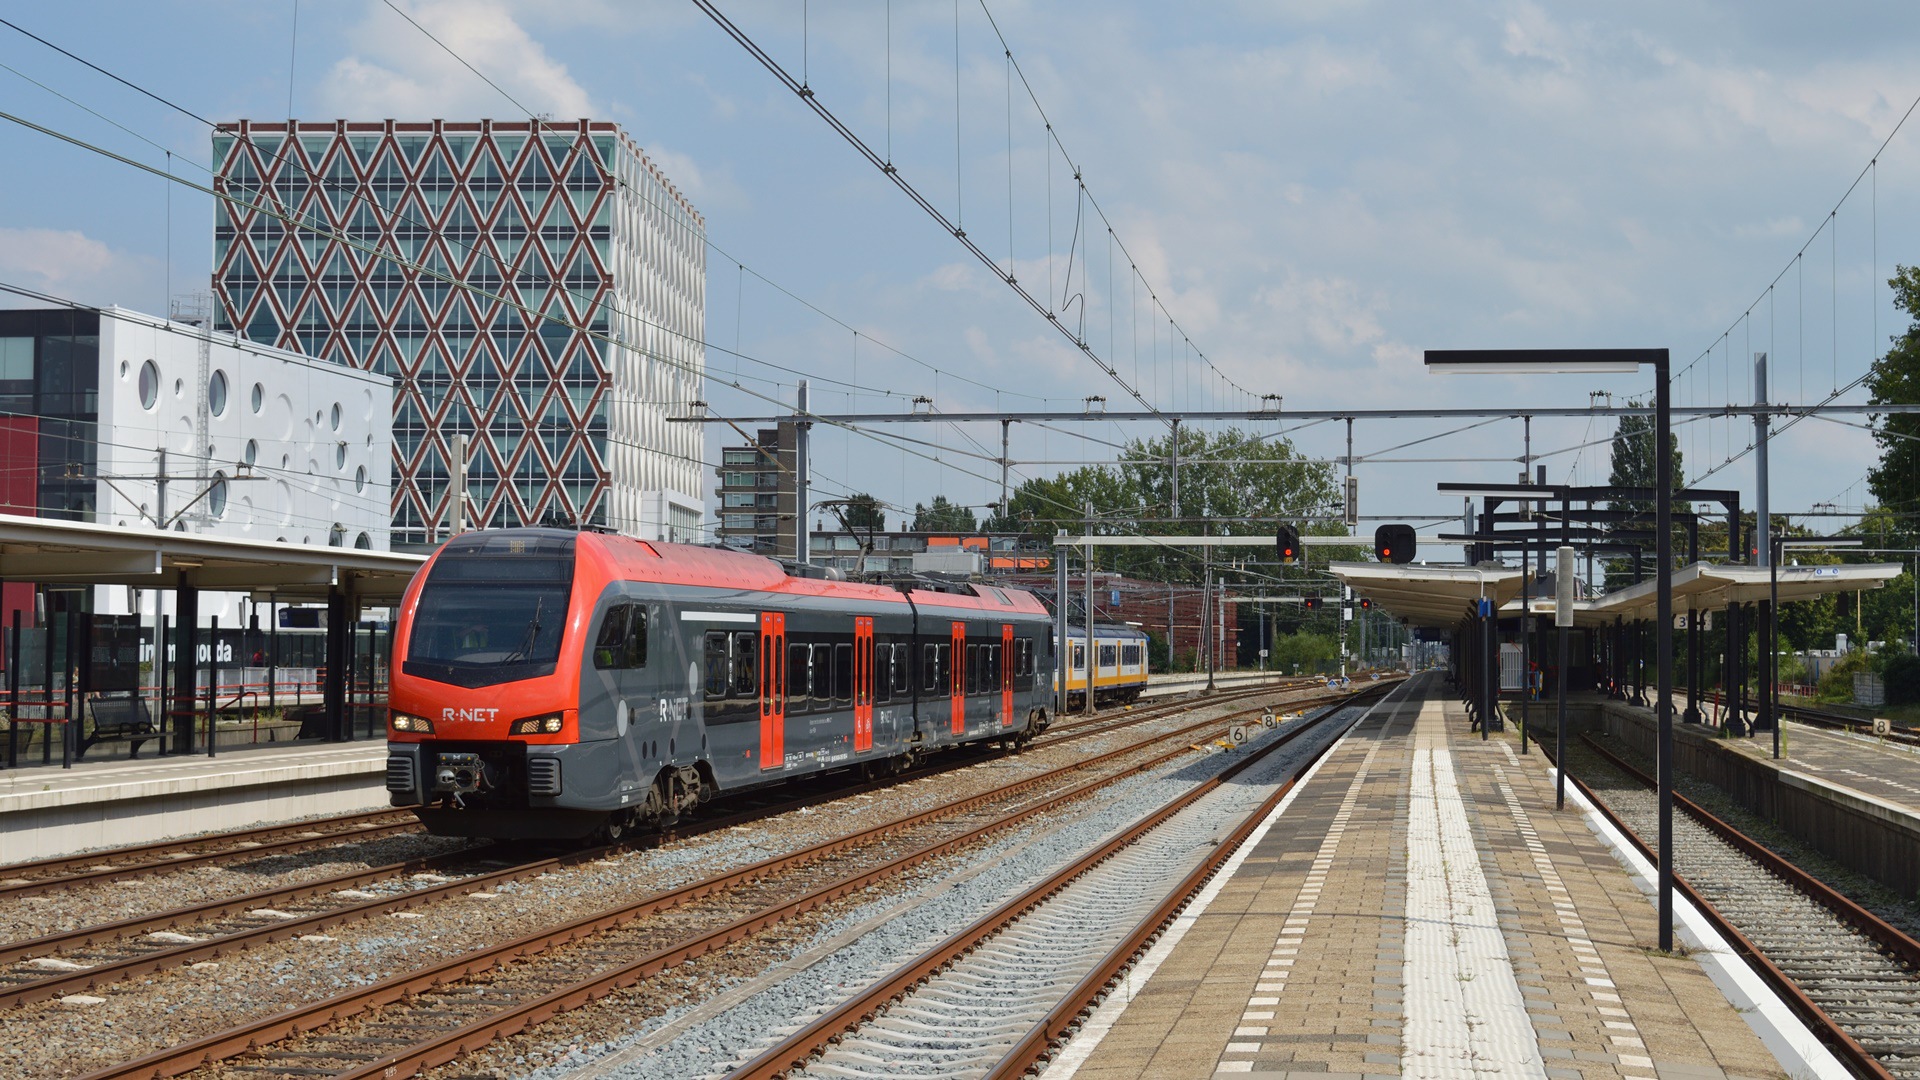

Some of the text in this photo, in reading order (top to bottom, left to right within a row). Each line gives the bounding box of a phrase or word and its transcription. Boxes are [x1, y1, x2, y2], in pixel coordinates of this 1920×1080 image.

[196, 639, 232, 665] ouda
[808, 643, 813, 667] 2
[1266, 715, 1273, 727] 8
[1877, 720, 1886, 733] 8
[1234, 728, 1243, 741] 6
